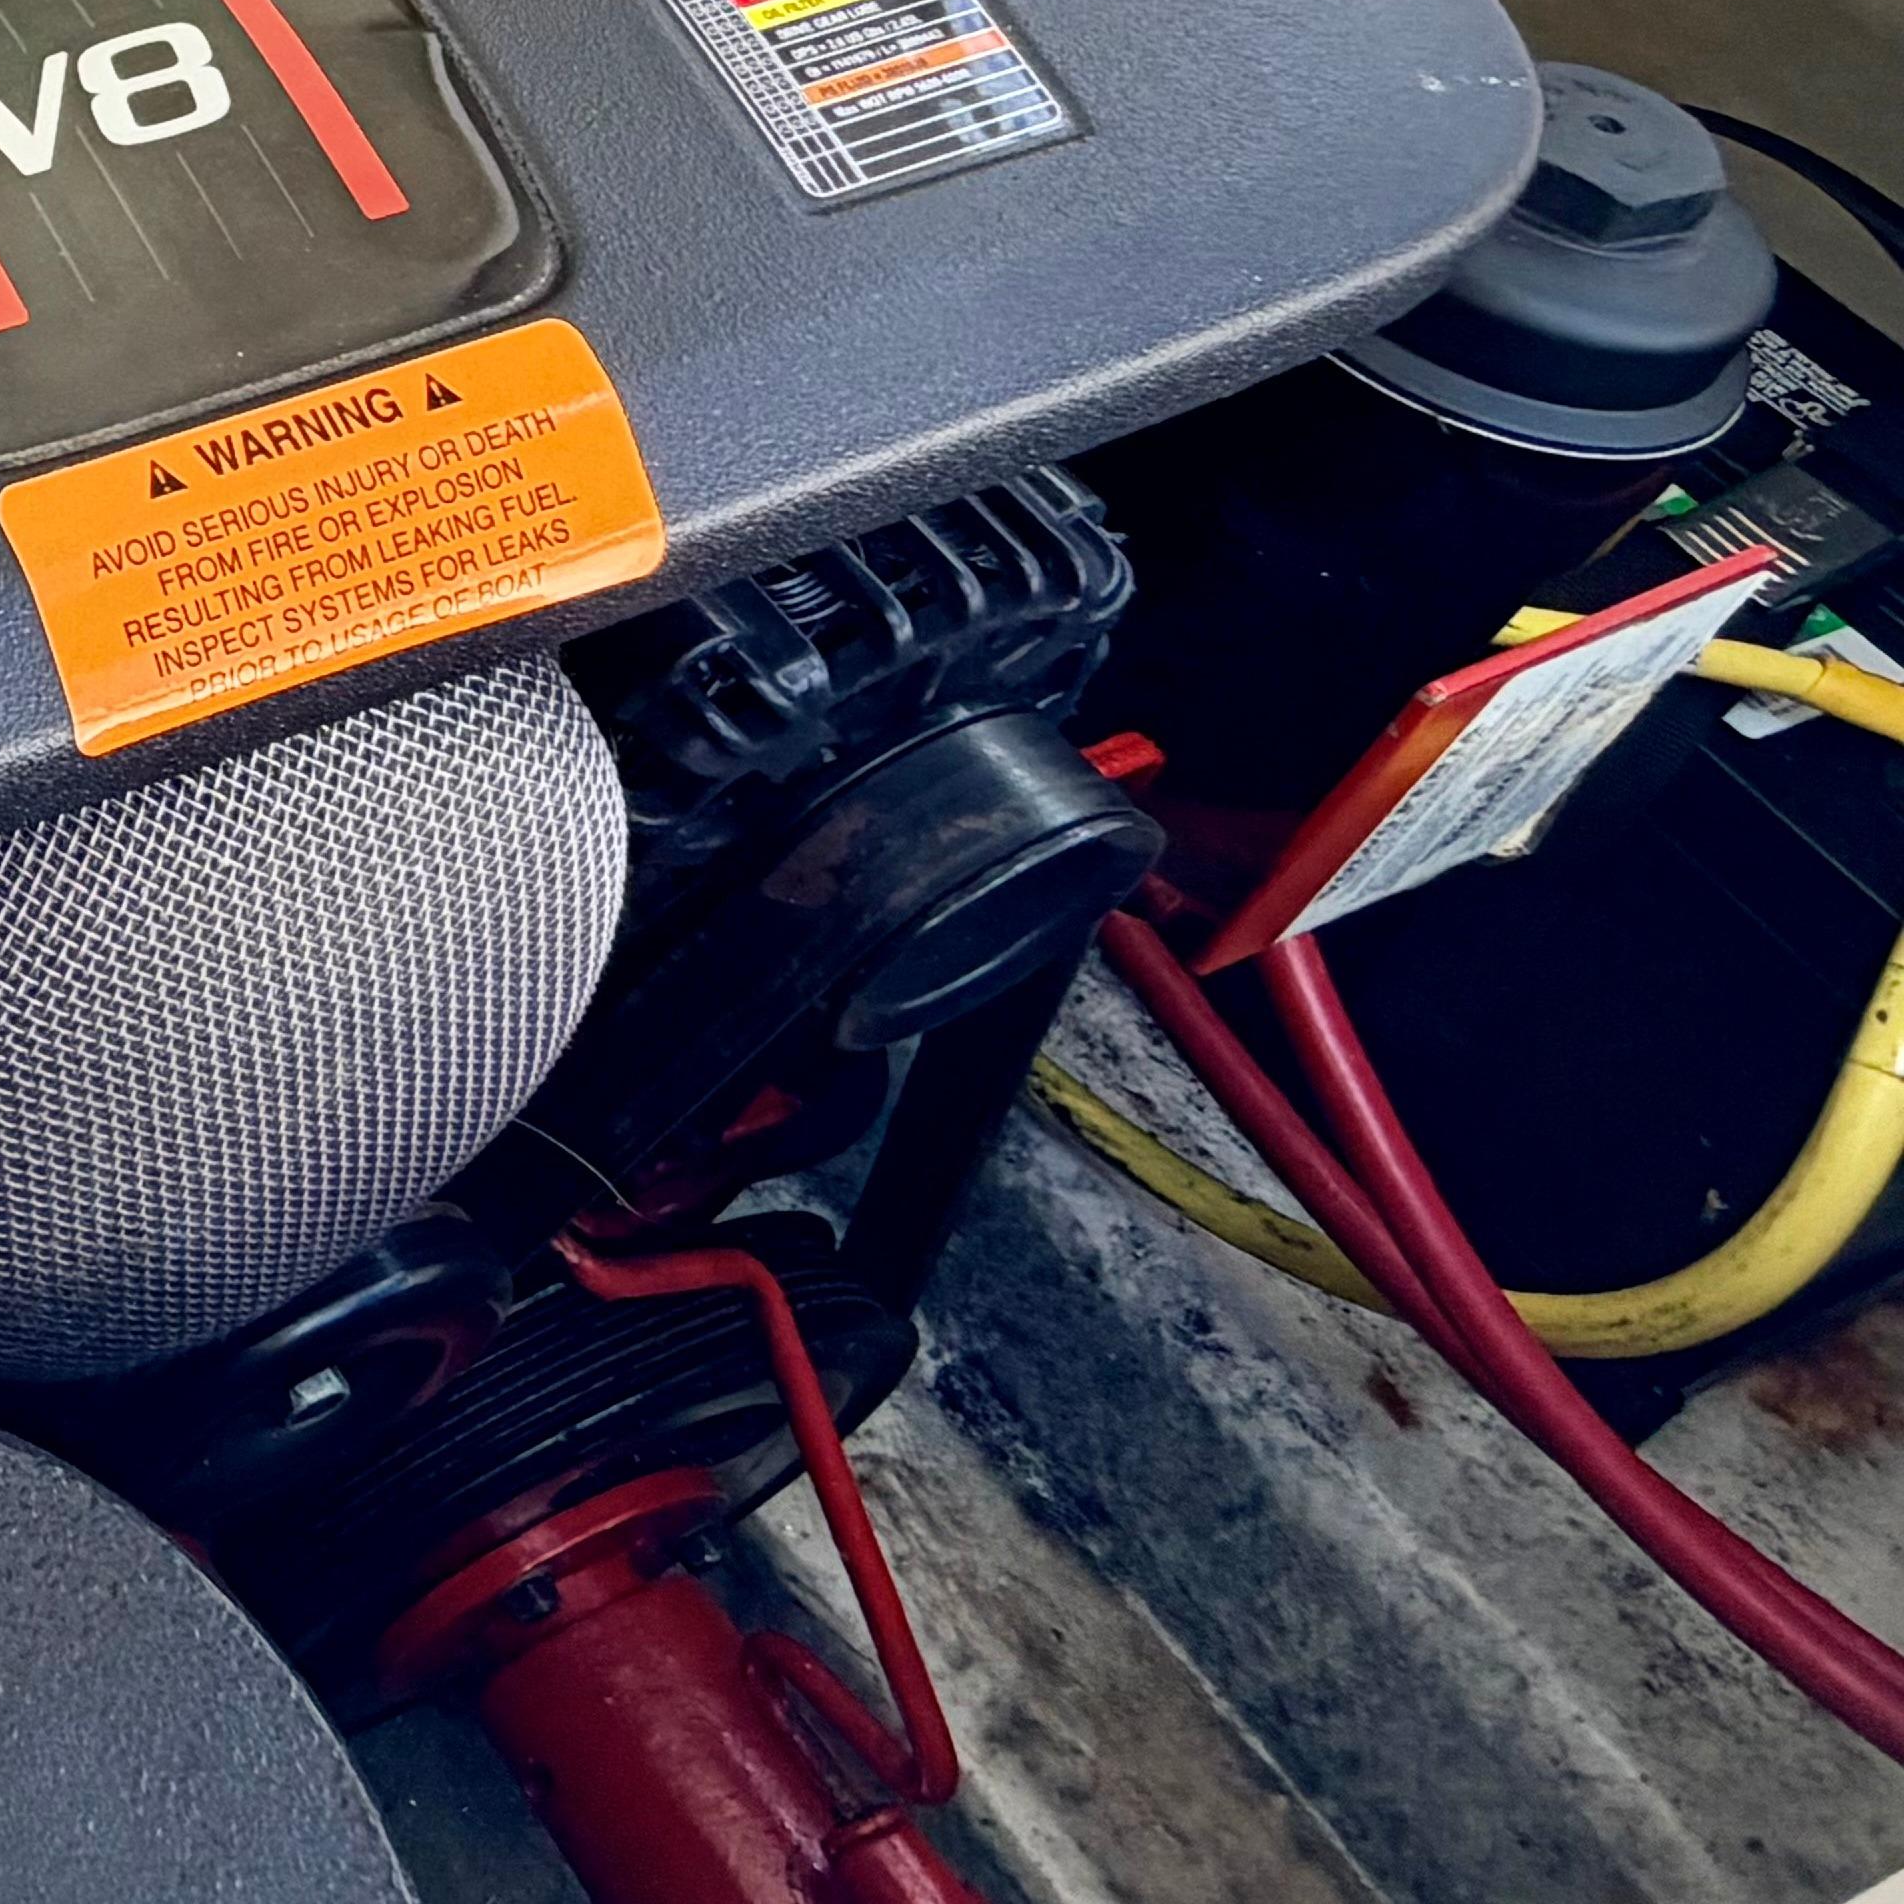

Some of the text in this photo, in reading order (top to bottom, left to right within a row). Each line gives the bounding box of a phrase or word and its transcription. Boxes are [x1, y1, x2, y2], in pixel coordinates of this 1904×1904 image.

[92, 407, 556, 580] AVOID SERIOUS INJURY OR DEATH
[194, 387, 404, 477] WARNING
[123, 480, 578, 647] RESULTING FROM LEAKING FUEL.
[155, 519, 571, 677] INSPECT SYSTEMS FOR LEAKS
[158, 458, 524, 596] FROM FIRE OR EXPLOSION
[188, 563, 548, 704] PRIOR TO USAGE OF BOAT
